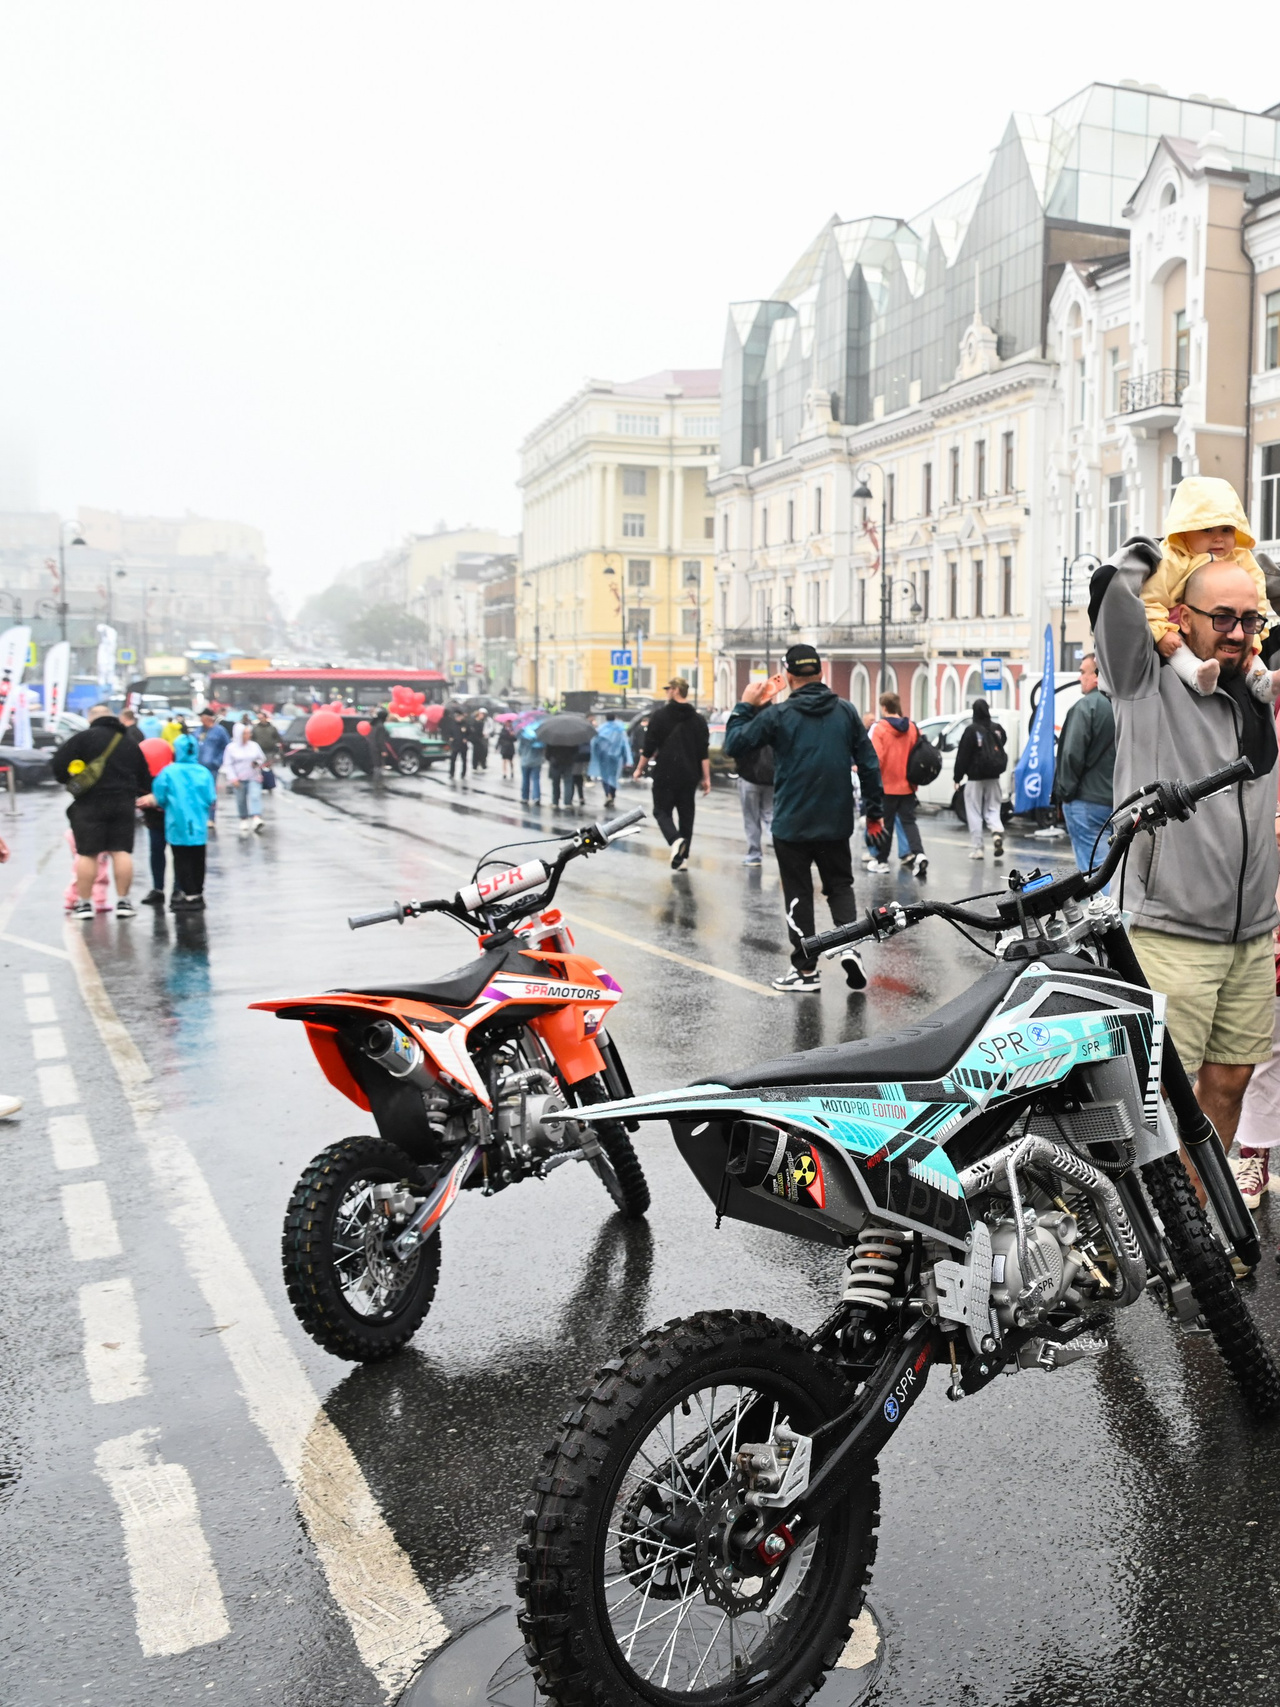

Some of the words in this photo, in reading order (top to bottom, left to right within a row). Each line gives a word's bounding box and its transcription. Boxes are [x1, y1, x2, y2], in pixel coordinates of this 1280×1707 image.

[477, 867, 525, 897] SPR
[525, 984, 601, 1000] SPRMOTORS
[978, 1031, 1029, 1065] SPR
[1081, 1040, 1101, 1057] SPR
[820, 1099, 870, 1116] MOTOPRO
[872, 1102, 907, 1120] EDITION
[895, 1367, 917, 1403] SPR
